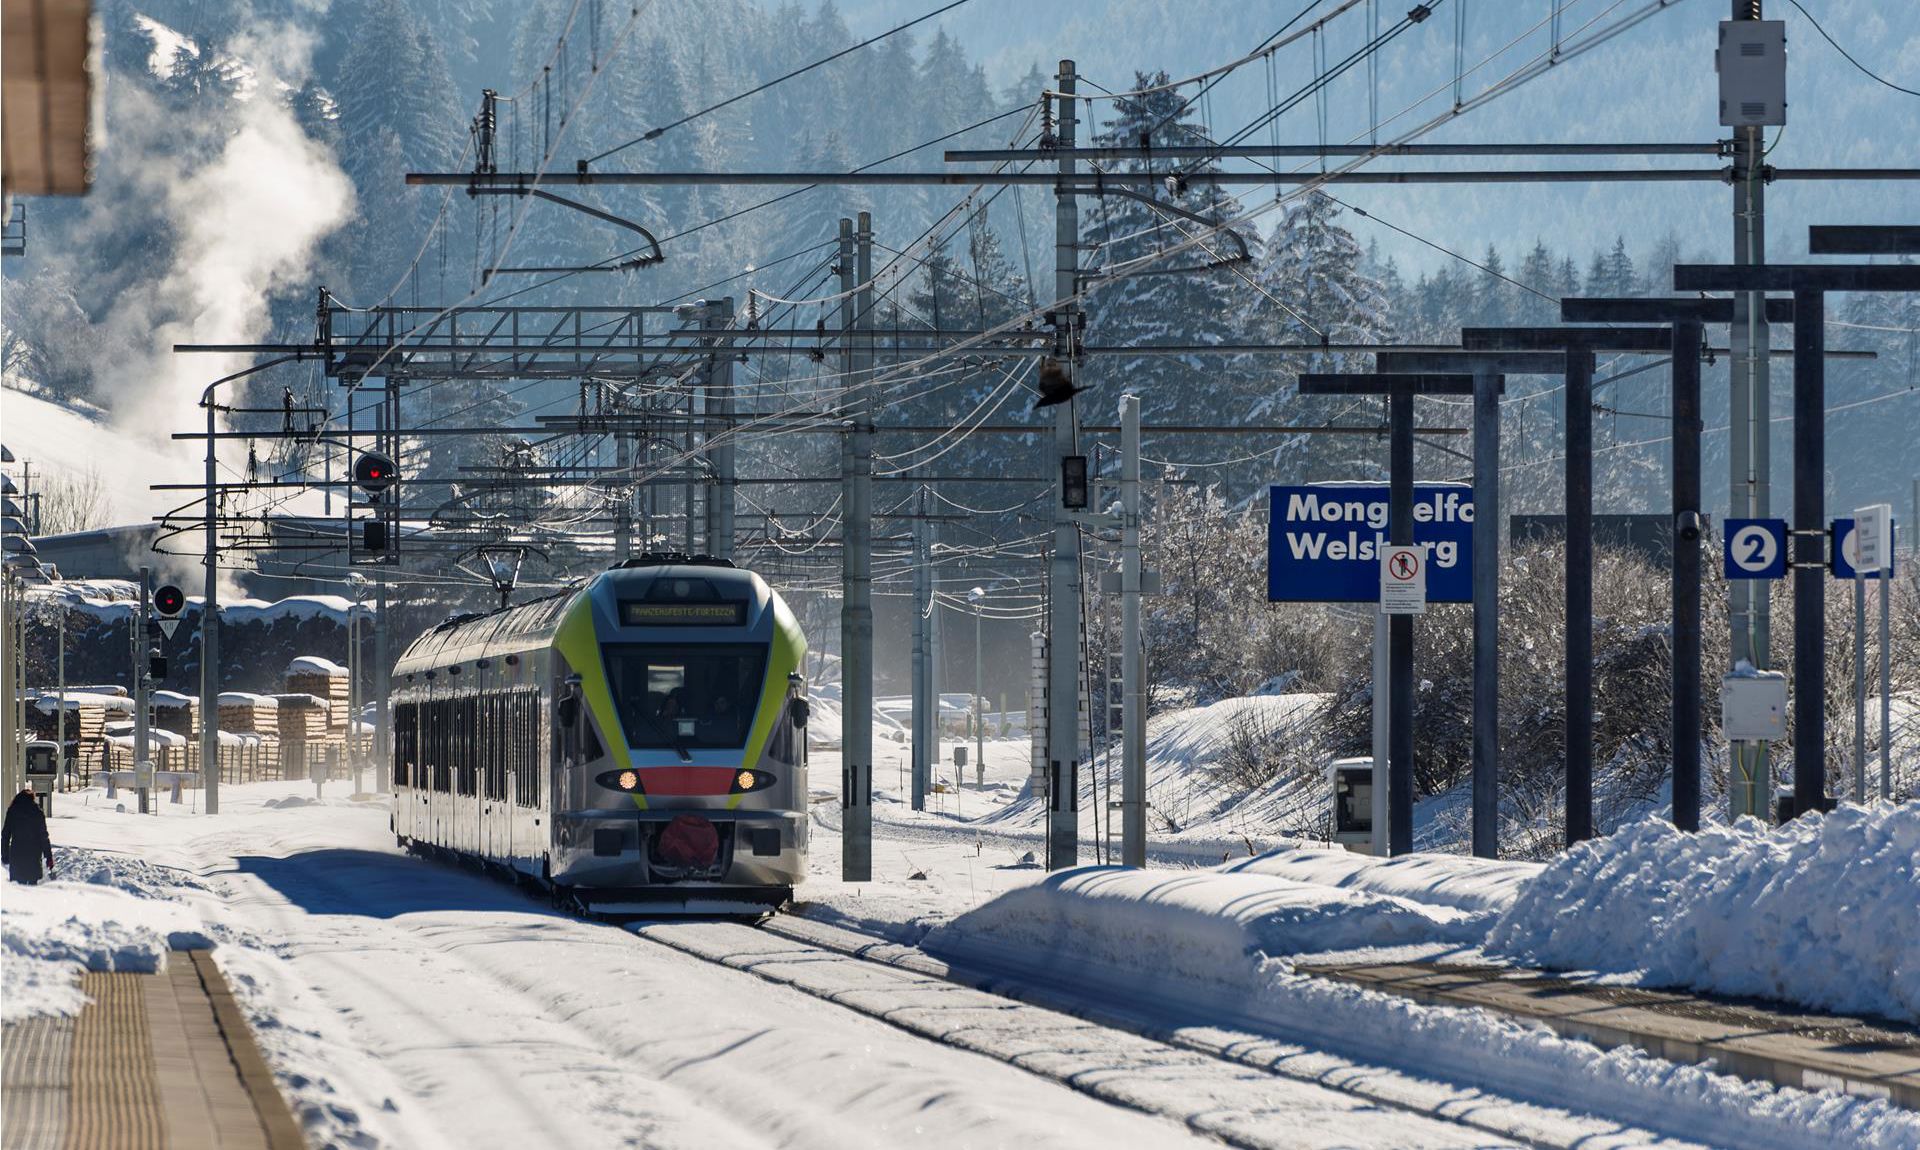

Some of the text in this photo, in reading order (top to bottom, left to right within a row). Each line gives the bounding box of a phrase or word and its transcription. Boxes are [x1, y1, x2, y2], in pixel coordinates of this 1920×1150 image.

[1286, 493, 1475, 529] Mongelfo
[1286, 531, 1458, 568] Welsrg
[1742, 533, 1766, 564] 2
